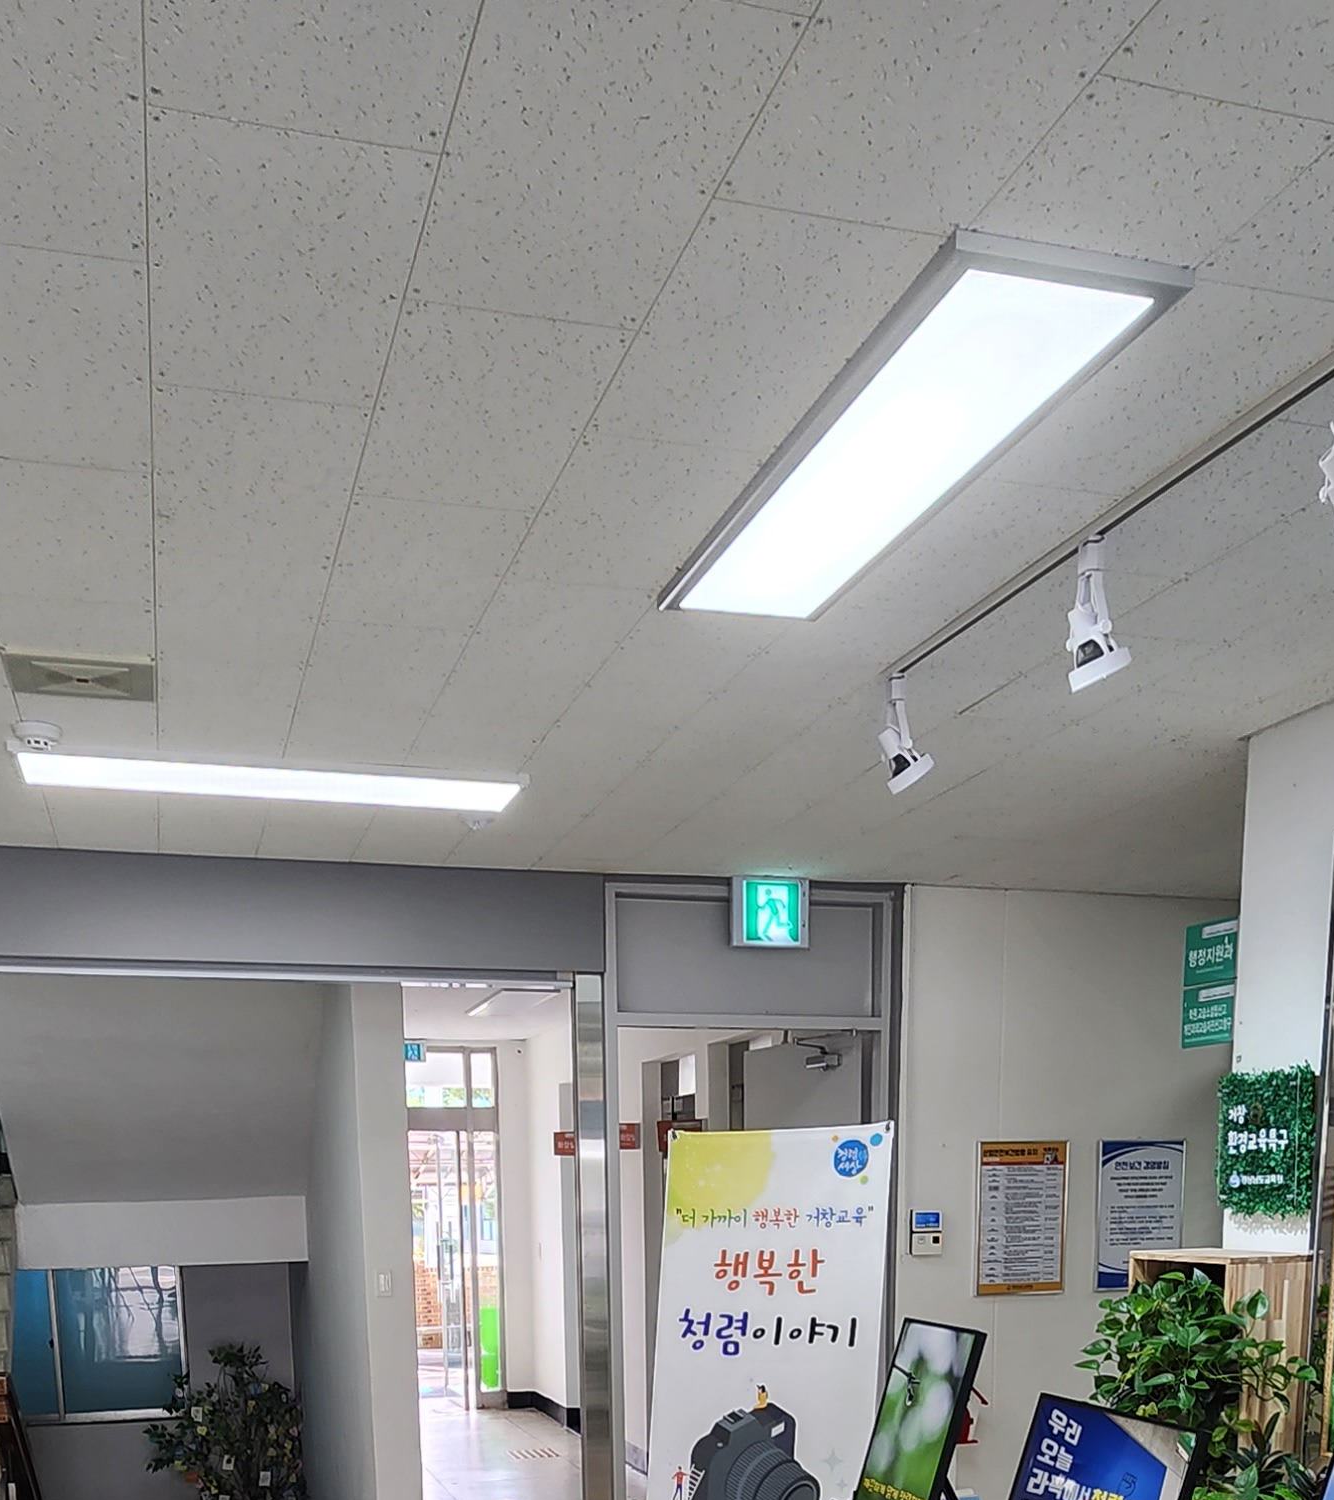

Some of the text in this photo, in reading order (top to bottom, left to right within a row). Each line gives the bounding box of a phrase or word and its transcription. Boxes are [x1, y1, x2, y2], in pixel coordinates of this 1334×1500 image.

[1188, 943, 1234, 968] 행정지원과
[1228, 1104, 1248, 1124] 거창
[1227, 1128, 1289, 1155] 환경교육특구
[701, 1207, 748, 1228] 가까이
[752, 1208, 800, 1229] 행복한
[713, 1249, 825, 1295] 행복한
[679, 1308, 858, 1356] 청렴이야기
[1048, 1409, 1082, 1446] 우리
[1036, 1437, 1074, 1473] 오늘
